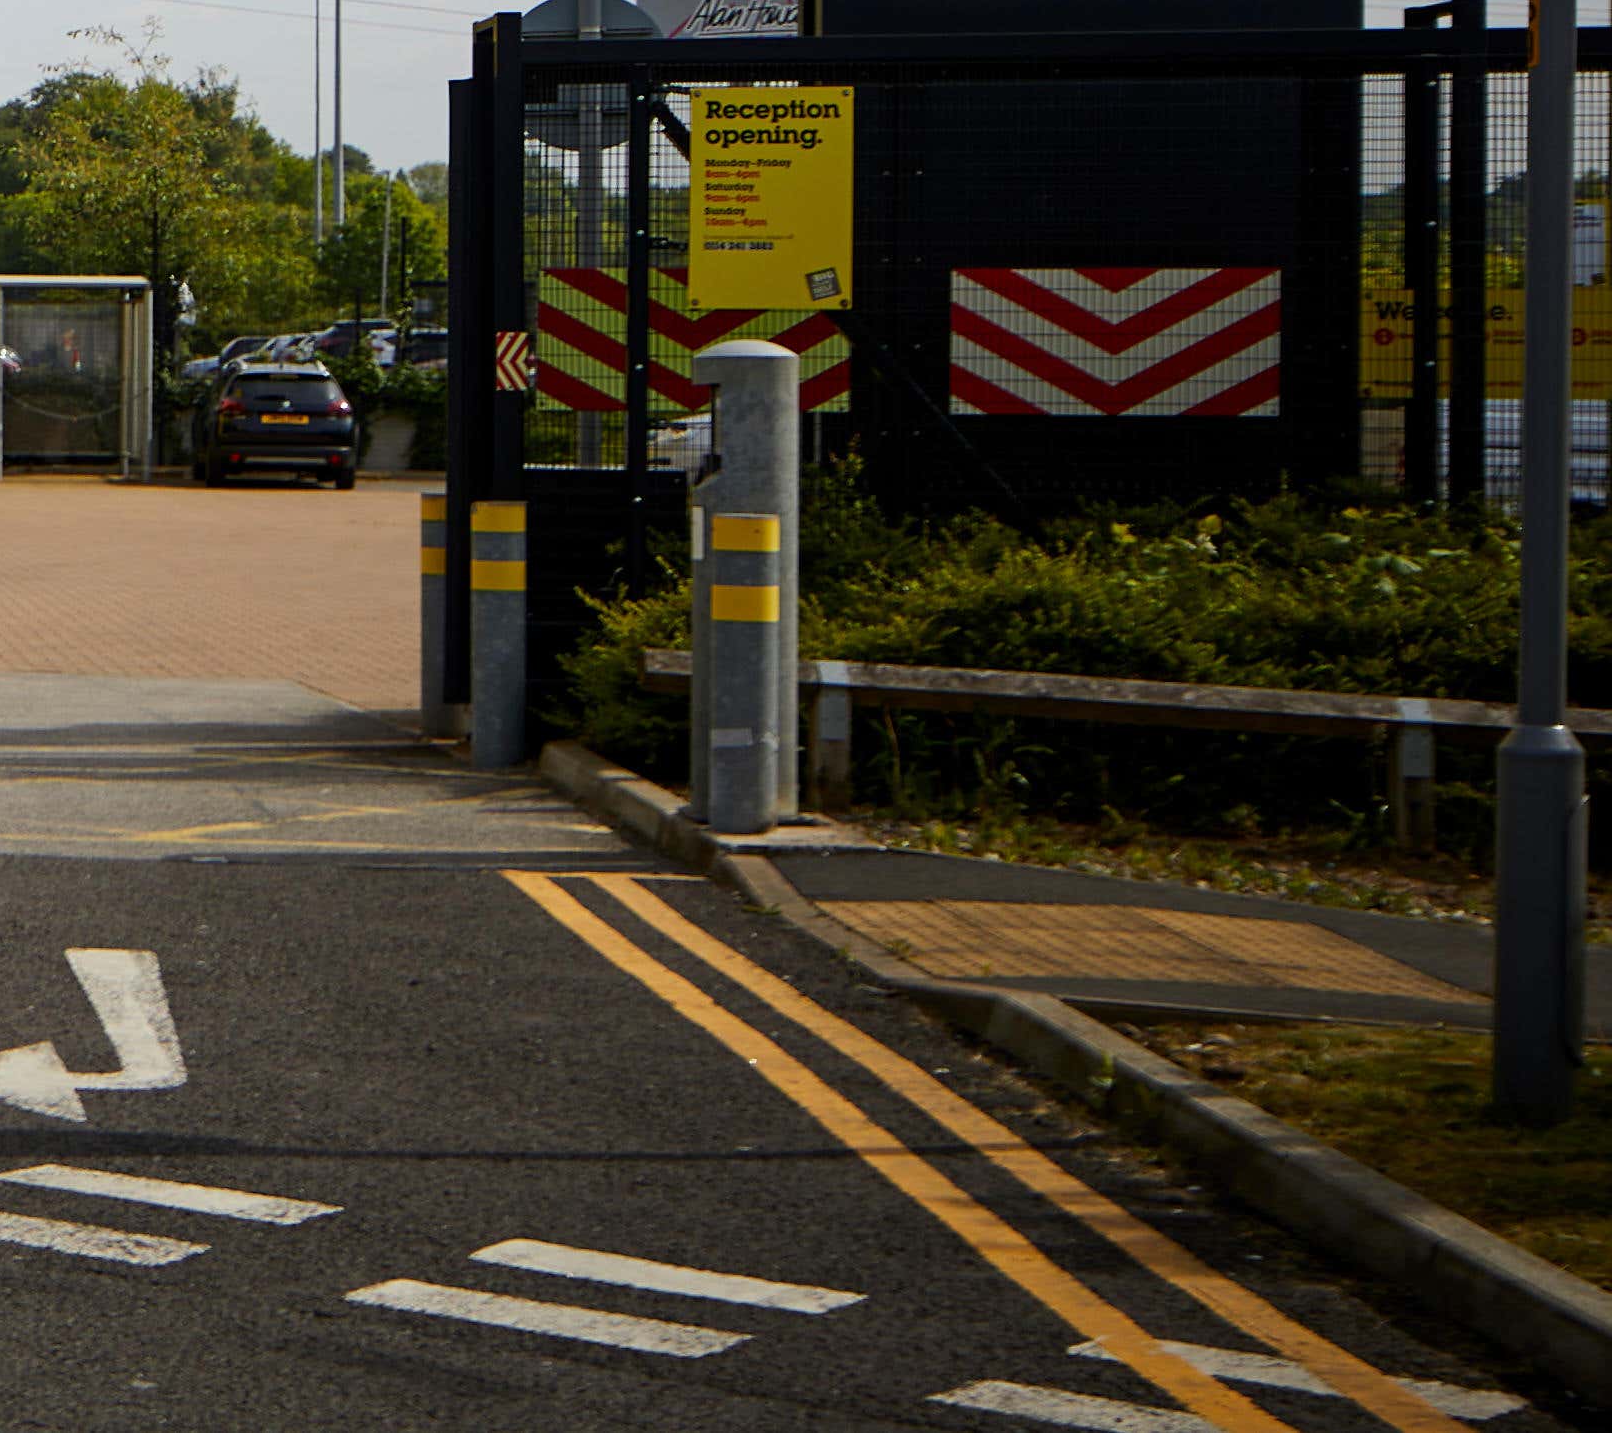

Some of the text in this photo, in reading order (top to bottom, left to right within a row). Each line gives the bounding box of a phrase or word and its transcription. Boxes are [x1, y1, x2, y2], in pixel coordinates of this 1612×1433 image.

[706, 100, 841, 123] Reception
[705, 125, 823, 149] opening.
[704, 183, 755, 193] Saturday
[704, 207, 746, 217] Sunday
